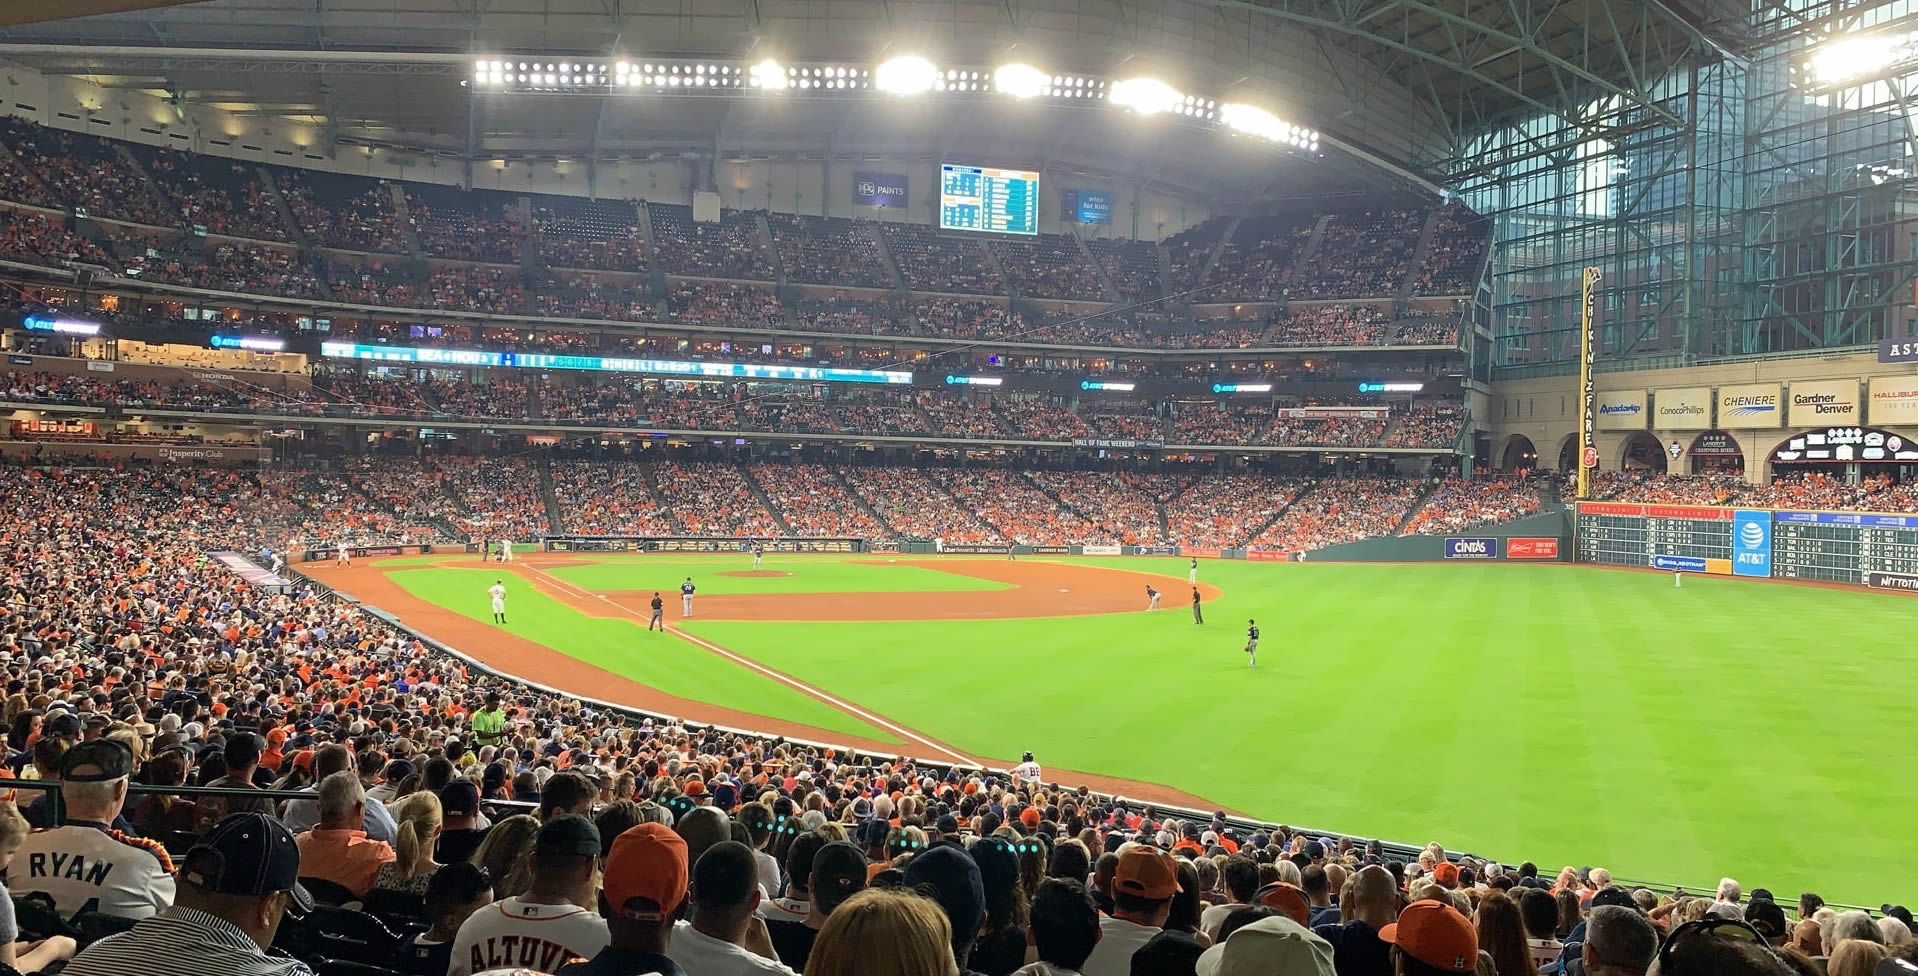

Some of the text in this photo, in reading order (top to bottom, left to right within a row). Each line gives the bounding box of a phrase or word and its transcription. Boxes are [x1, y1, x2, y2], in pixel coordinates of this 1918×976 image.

[878, 186, 904, 196] PAINTS
[1724, 396, 1775, 406] CHENIERE
[1794, 394, 1836, 404] Gardner
[1660, 405, 1704, 416] ConocoPhillips
[1816, 404, 1854, 414] Denver
[169, 448, 222, 458] Insperity Club
[1738, 554, 1766, 564] AT&T
[30, 852, 113, 886] RYAN
